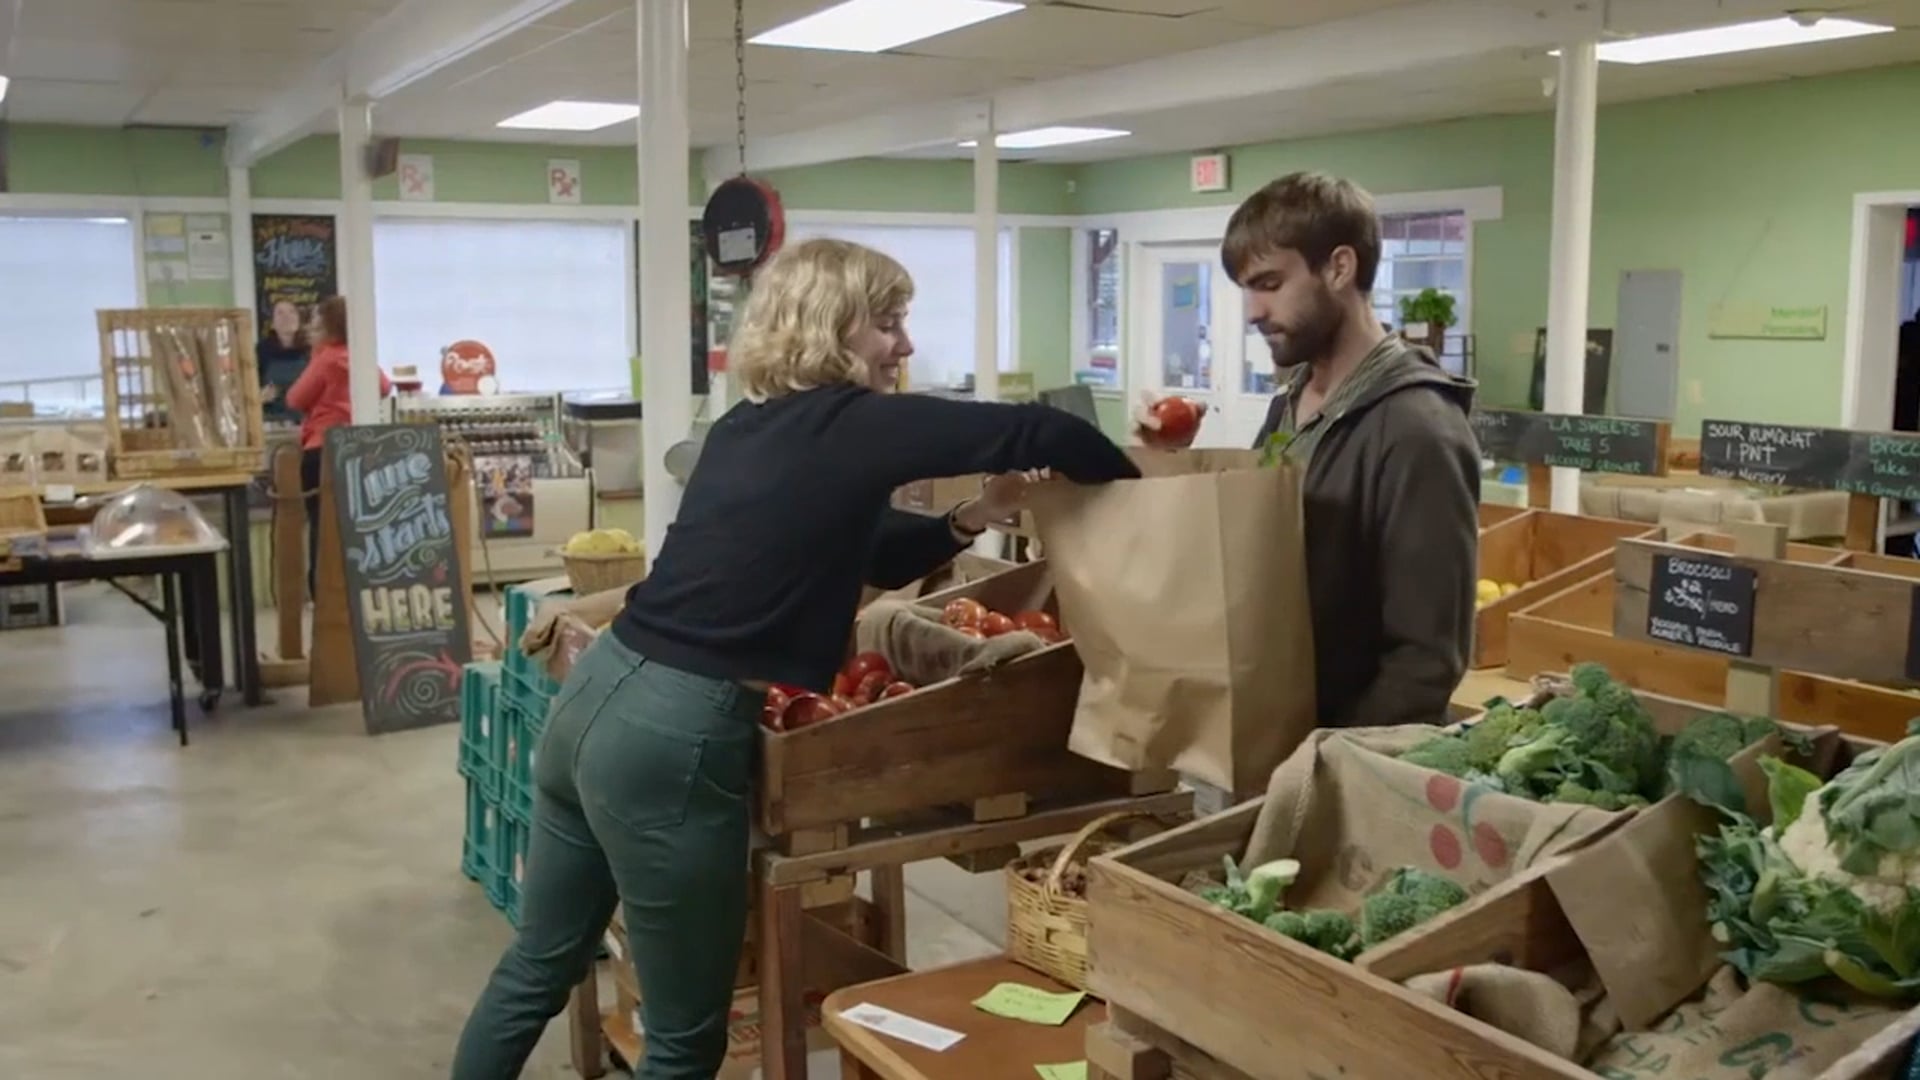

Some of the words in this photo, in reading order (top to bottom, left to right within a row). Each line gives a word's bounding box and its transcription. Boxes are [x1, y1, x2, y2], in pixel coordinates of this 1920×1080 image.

[1558, 436, 1592, 454] TAKE
[1708, 424, 1745, 441] SOUR
[1748, 424, 1817, 449] KUMQUAT
[1668, 557, 1732, 581] BROCCOLI
[360, 583, 456, 634] HERE
